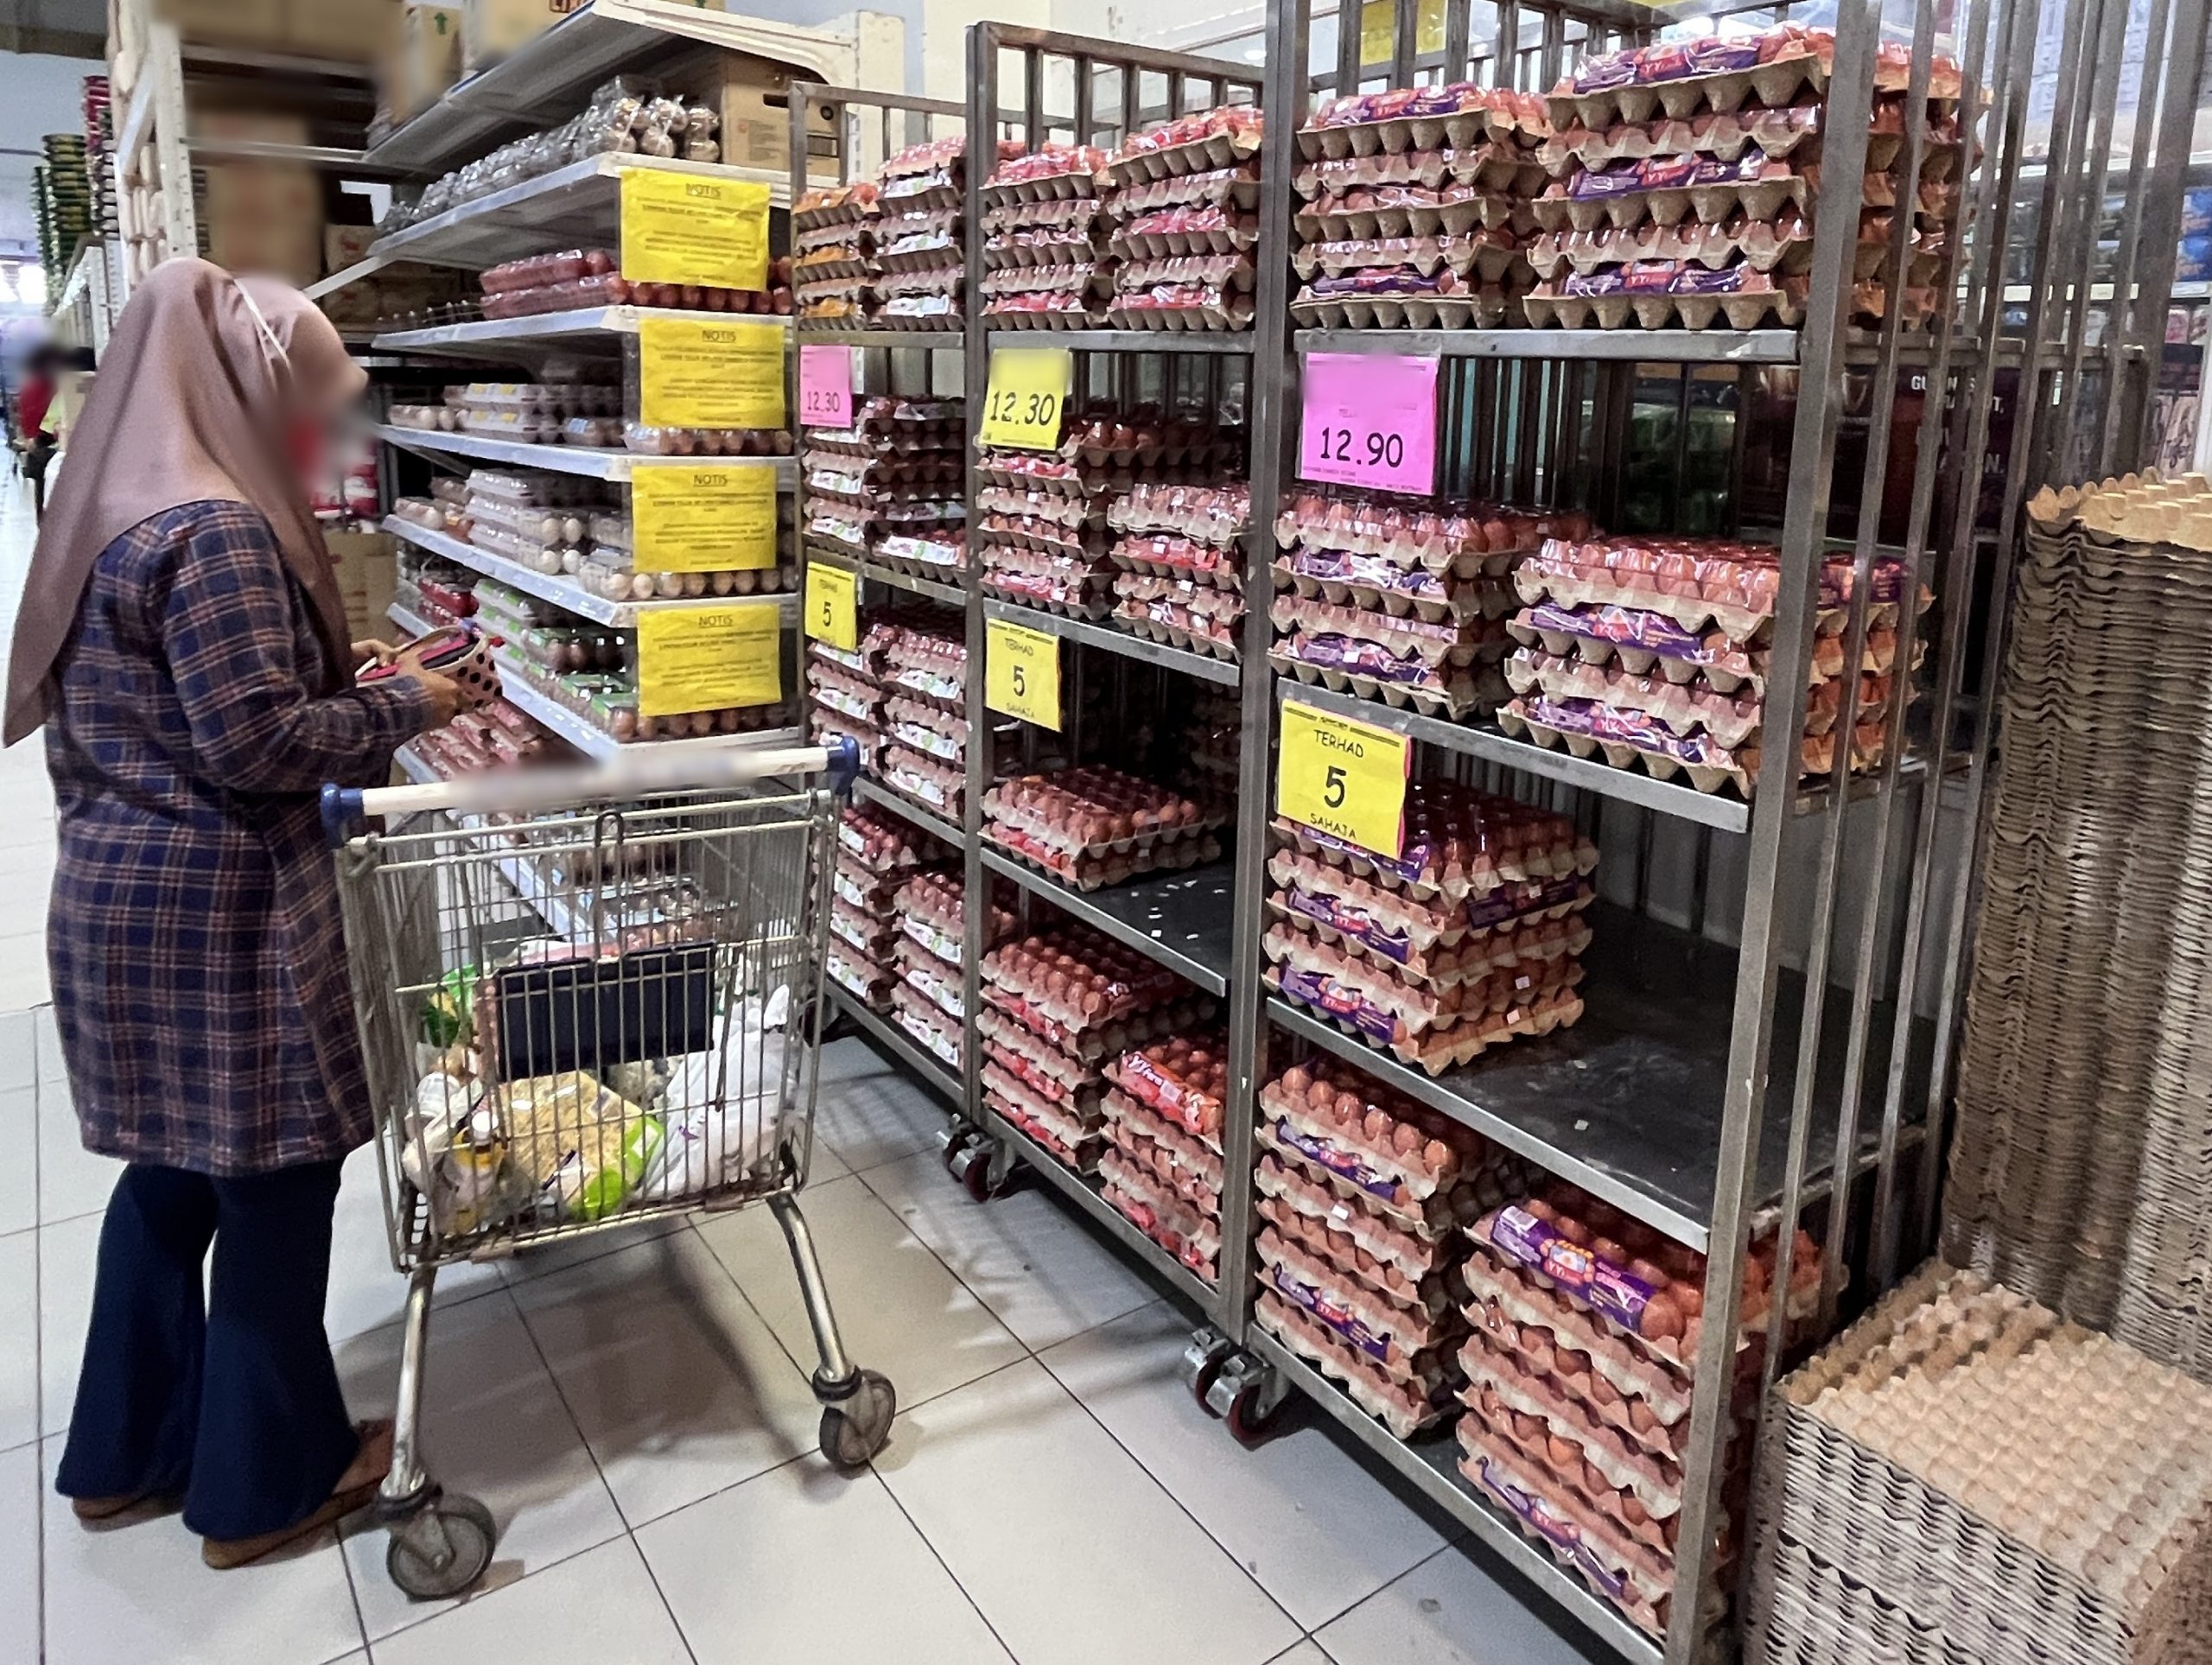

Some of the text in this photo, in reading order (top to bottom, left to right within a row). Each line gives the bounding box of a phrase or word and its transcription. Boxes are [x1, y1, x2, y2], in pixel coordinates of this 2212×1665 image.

[702, 330, 736, 341] NOTIS
[990, 391, 1055, 426] 12.30
[1320, 427, 1403, 467] 12.90
[693, 474, 728, 485] NOTIS
[698, 614, 733, 626] NOTIS
[823, 601, 831, 627] 5
[1014, 664, 1025, 697] 5
[1313, 728, 1364, 759] TERHAD
[1324, 765, 1347, 809] 5
[1310, 812, 1357, 841] SAHAJA
